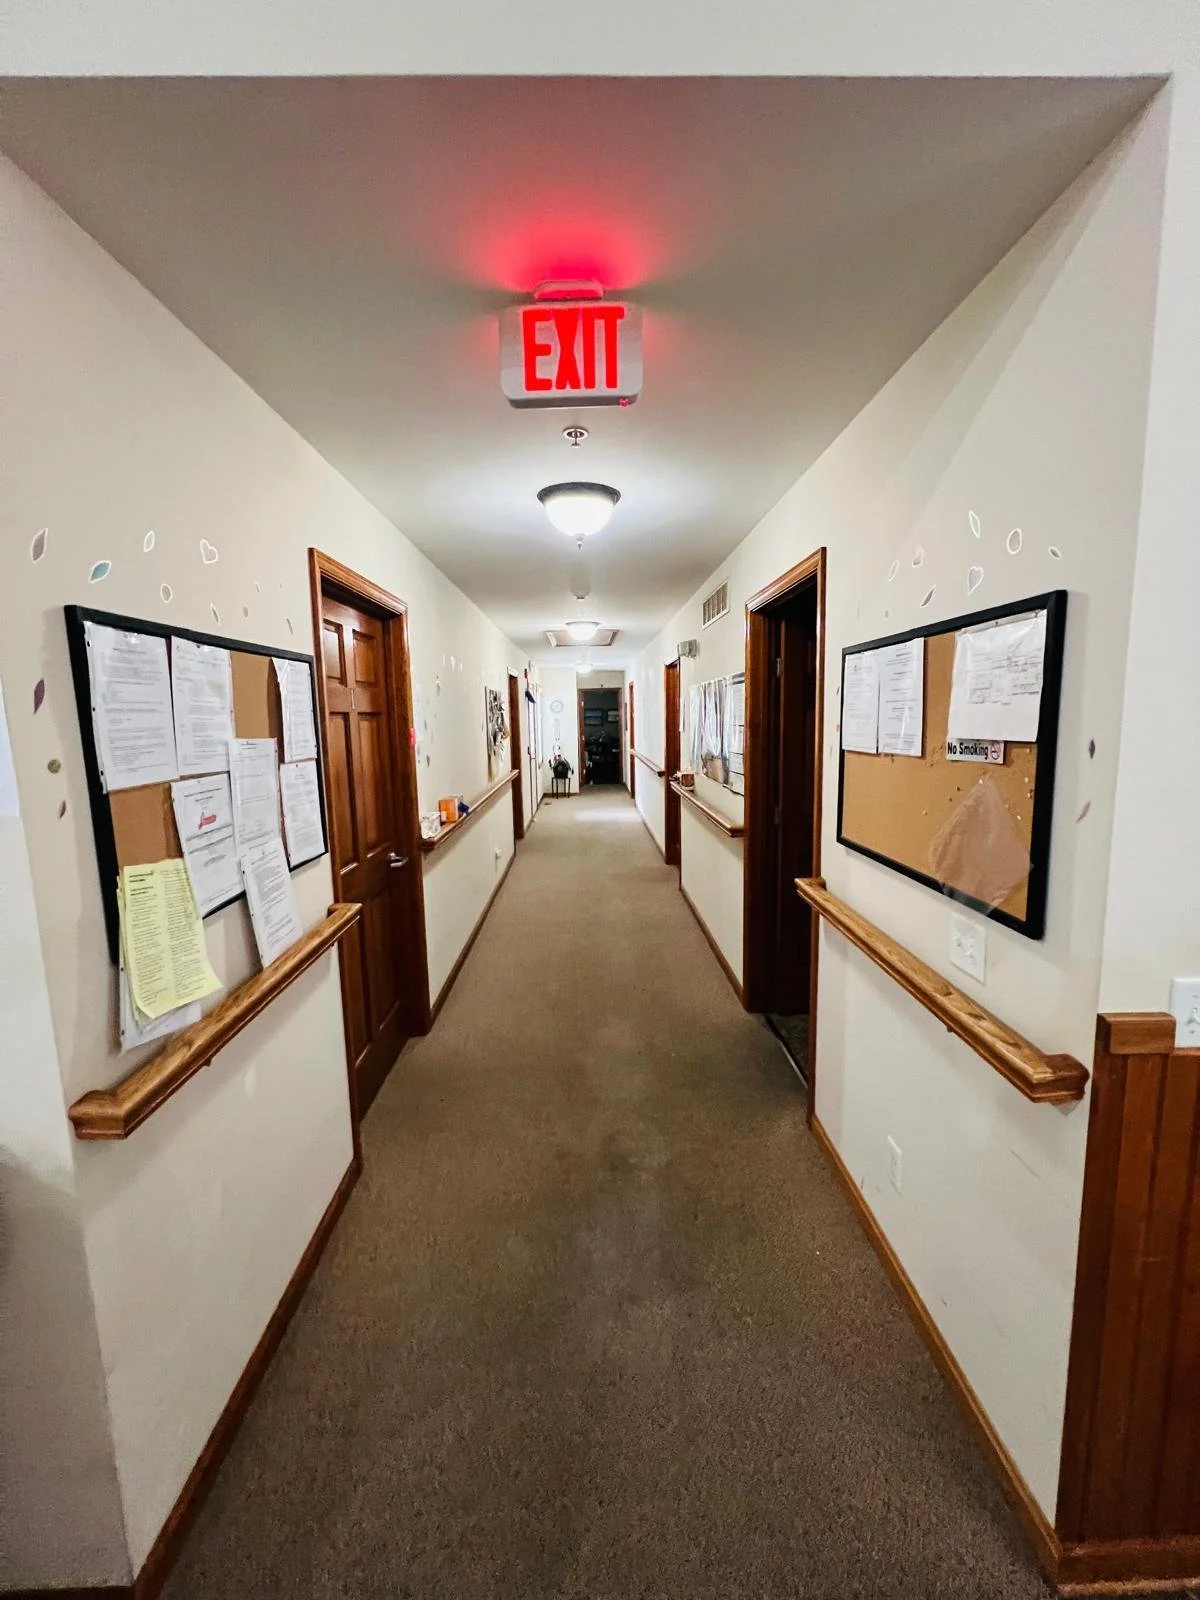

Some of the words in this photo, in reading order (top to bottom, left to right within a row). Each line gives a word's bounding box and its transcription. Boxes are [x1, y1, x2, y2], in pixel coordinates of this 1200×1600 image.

[522, 306, 625, 392] EXIT
[947, 741, 957, 755] No
[959, 741, 989, 760] Smoking
